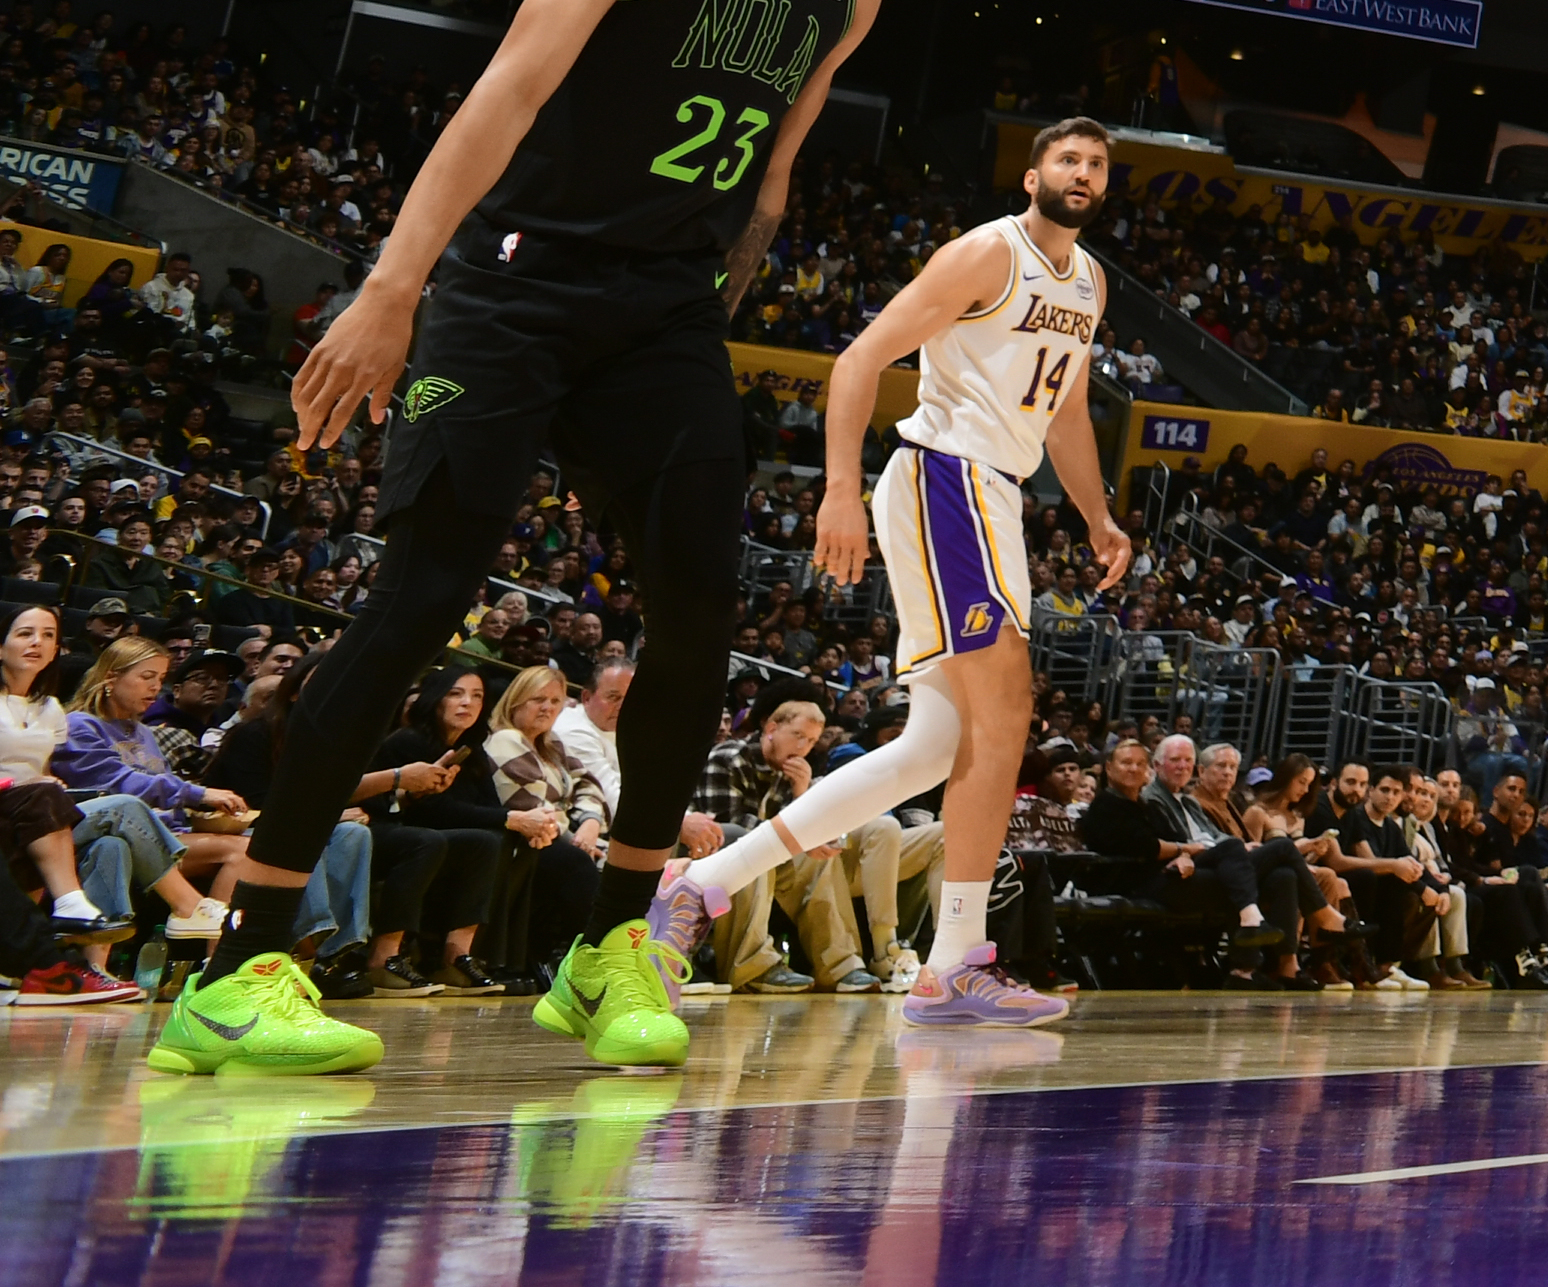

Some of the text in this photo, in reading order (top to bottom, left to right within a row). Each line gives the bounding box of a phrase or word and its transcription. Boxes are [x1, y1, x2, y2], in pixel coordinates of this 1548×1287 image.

[650, 94, 772, 193] 23
[1012, 293, 1093, 341] LAKERS
[1020, 345, 1070, 414] 14
[1153, 420, 1198, 447] 114
